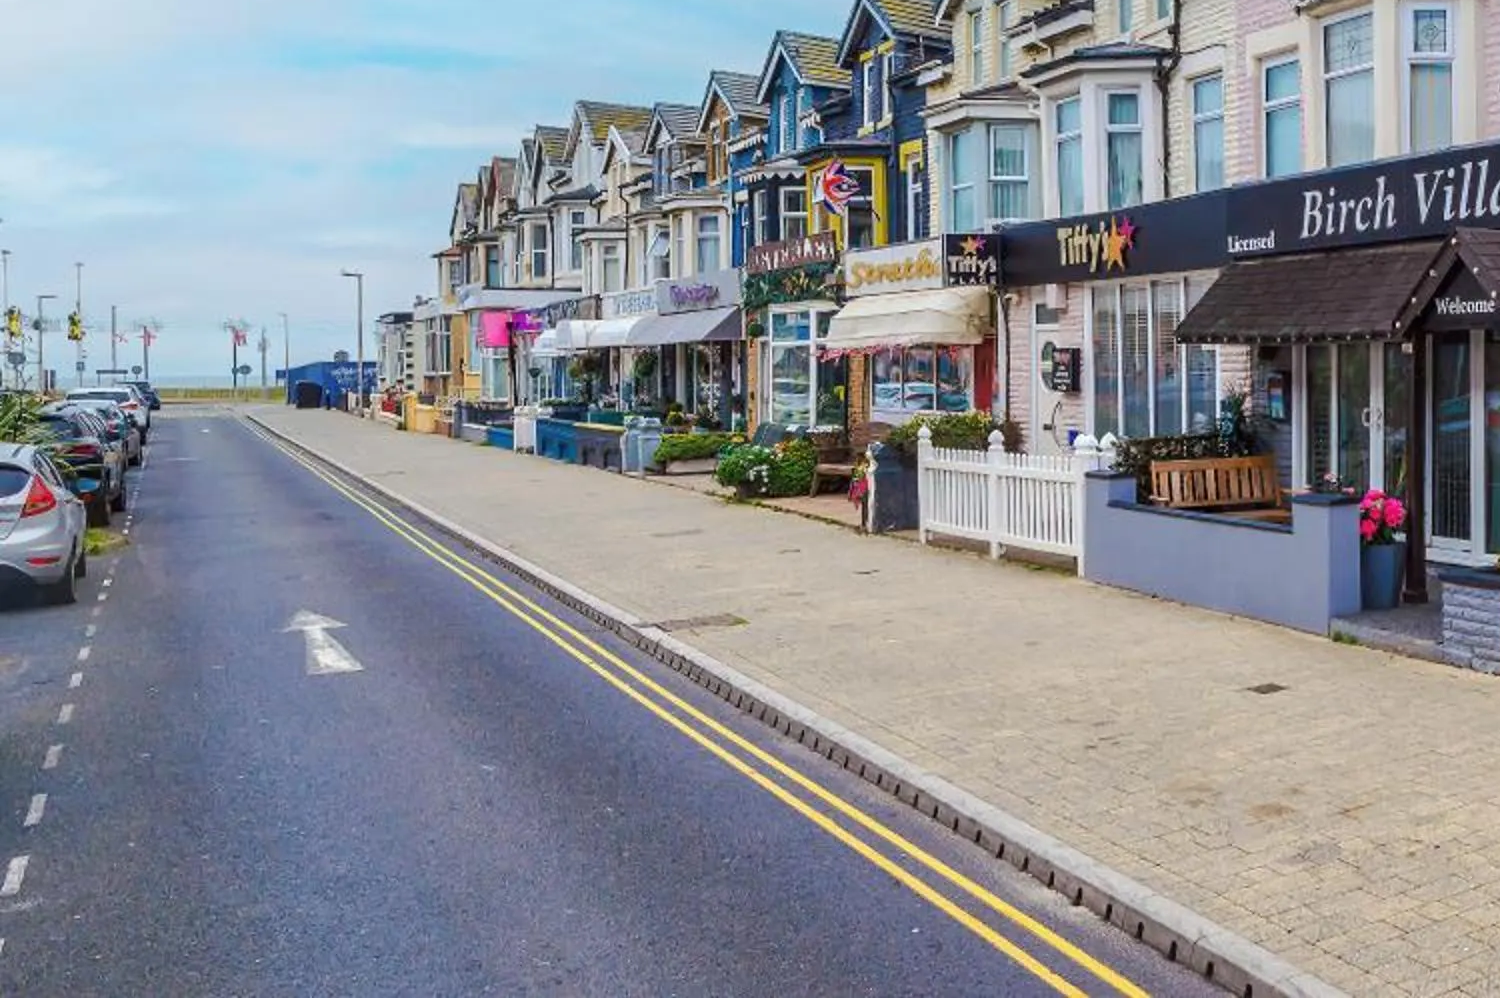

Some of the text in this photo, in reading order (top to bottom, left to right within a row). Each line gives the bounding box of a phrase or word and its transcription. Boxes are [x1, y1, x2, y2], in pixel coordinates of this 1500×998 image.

[1300, 175, 1397, 238] Birch
[1227, 229, 1275, 253] Licensed
[948, 254, 997, 276] Tiffy's
[1435, 297, 1496, 315] Welcome
